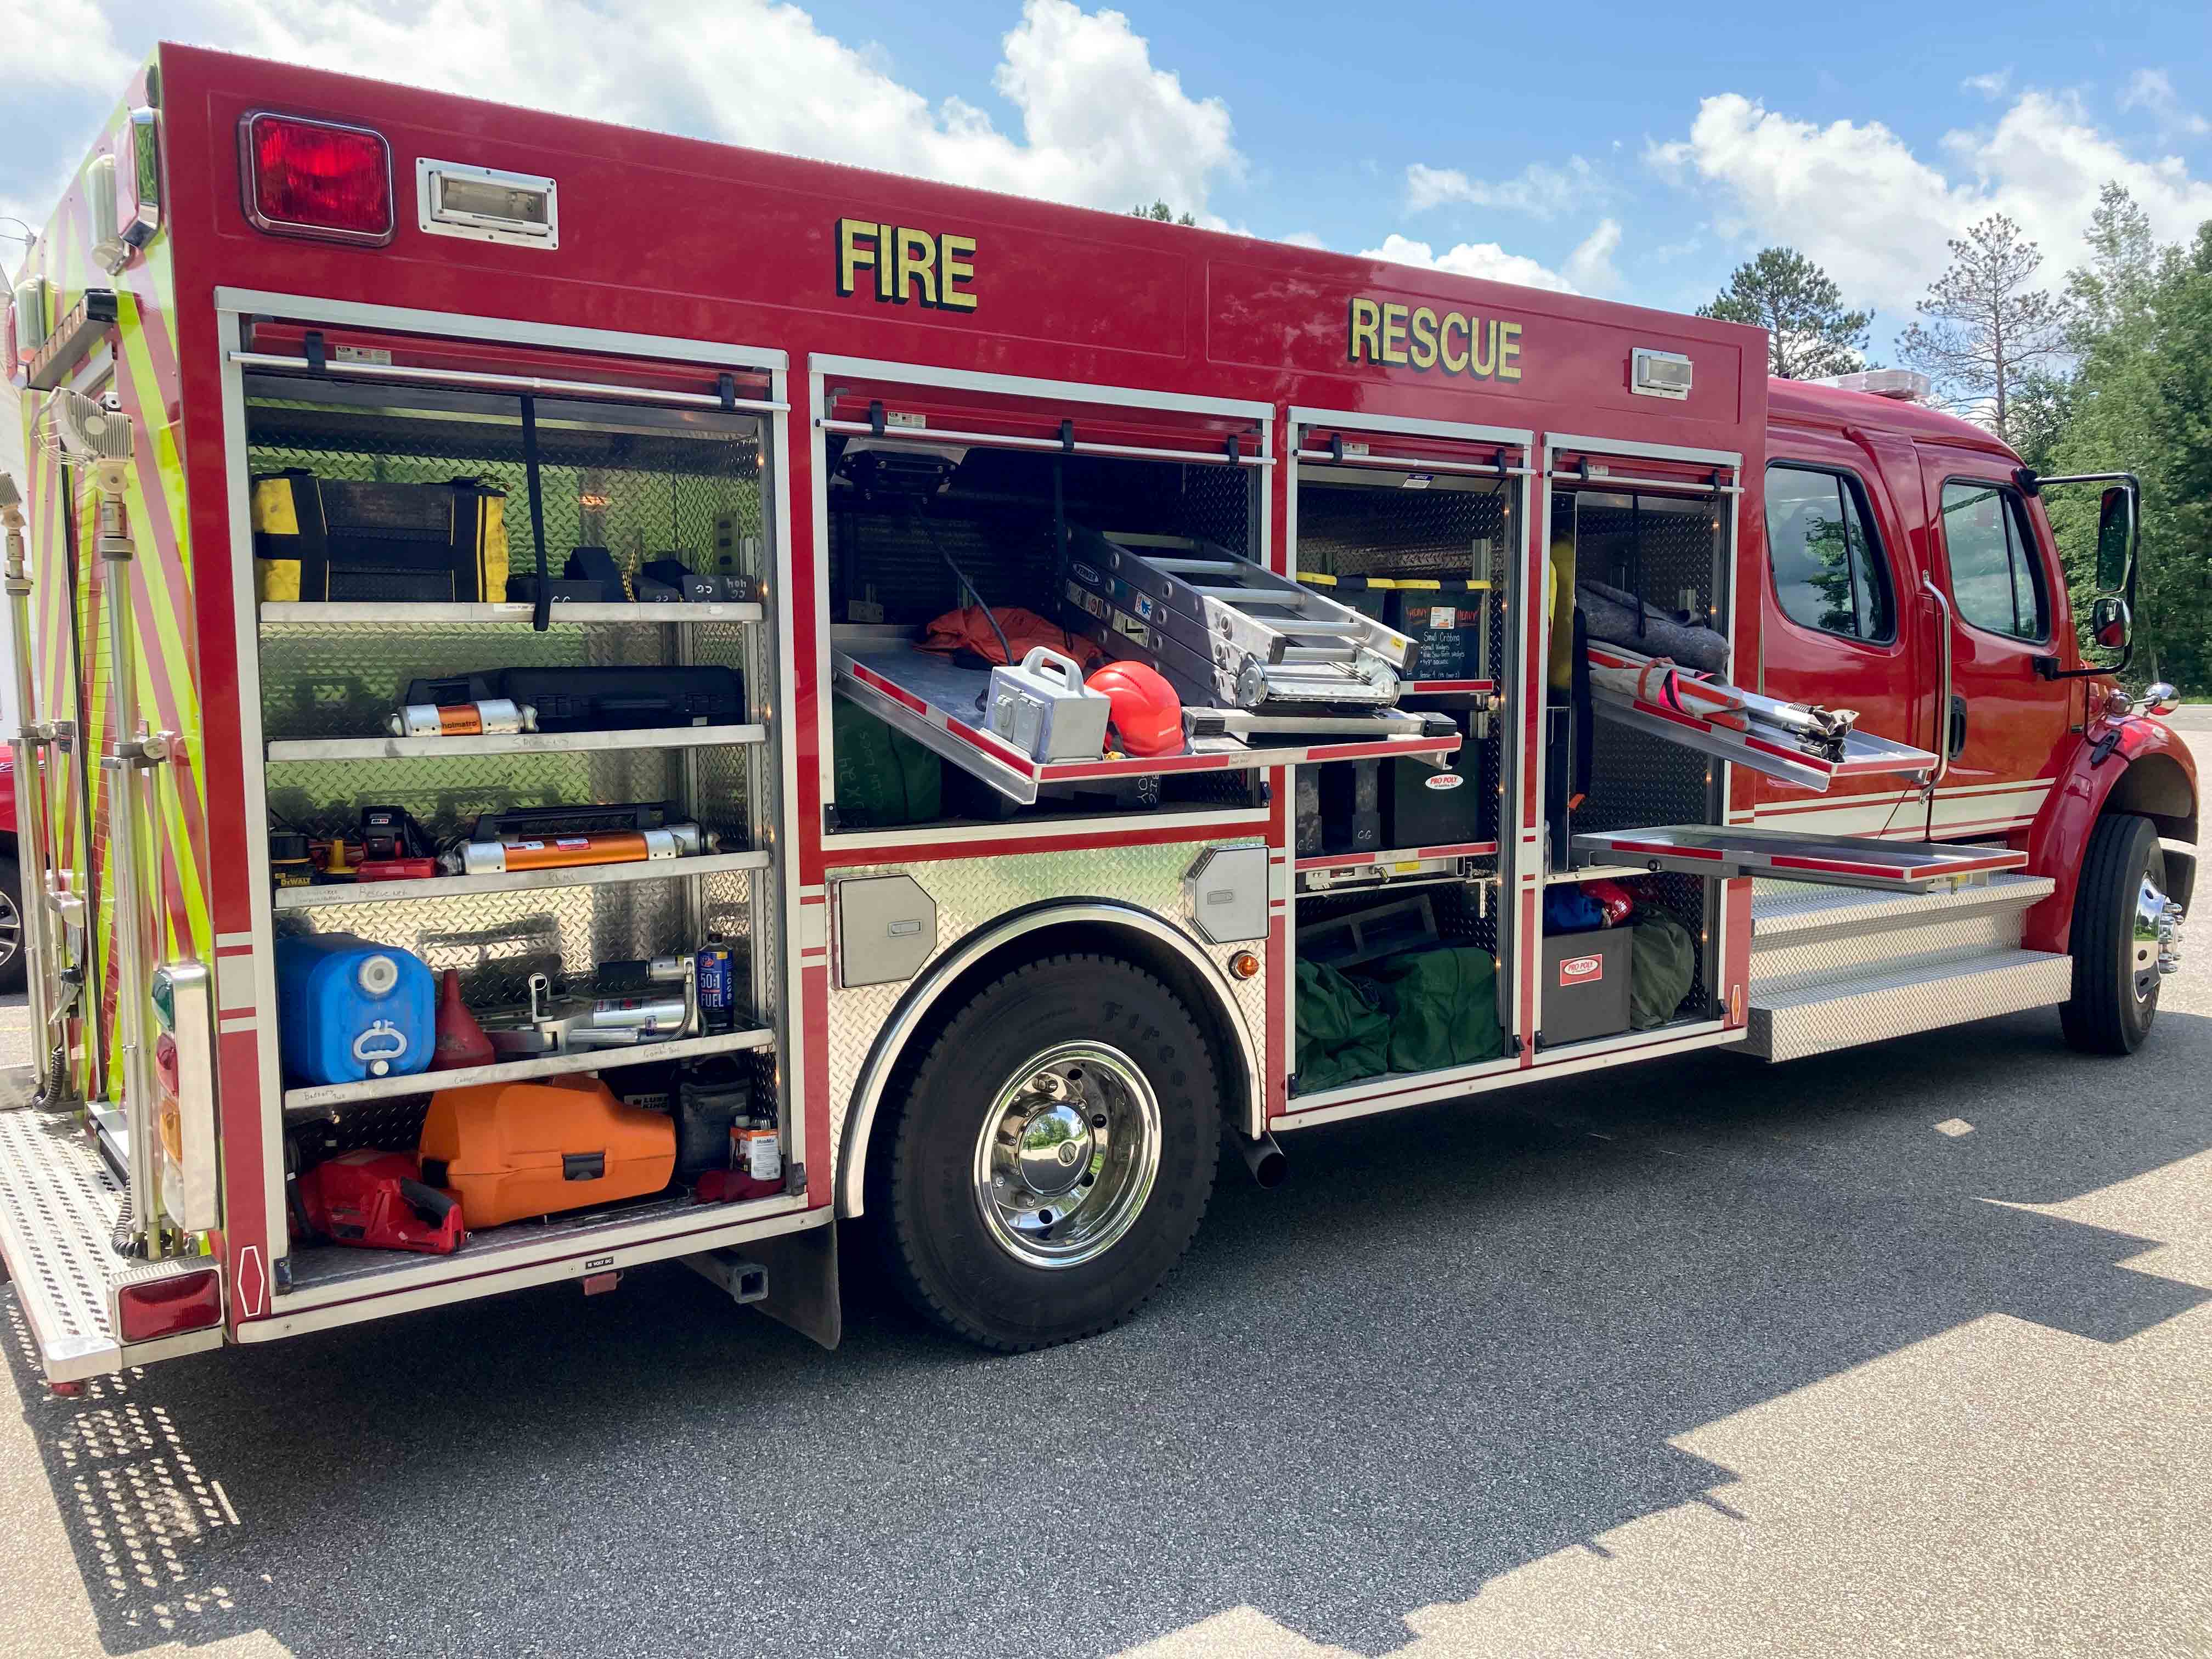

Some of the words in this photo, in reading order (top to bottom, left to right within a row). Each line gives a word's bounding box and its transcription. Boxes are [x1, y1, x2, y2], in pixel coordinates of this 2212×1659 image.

[837, 217, 977, 311] FIRE
[1350, 298, 1522, 382] RESCUE
[1457, 610, 1477, 622] HEAVY
[1424, 631, 1437, 642] Small
[1357, 830, 1372, 839] CG
[1568, 963, 1579, 972] PRO
[701, 973, 720, 988] 50:1
[701, 994, 724, 1007] FUEL
